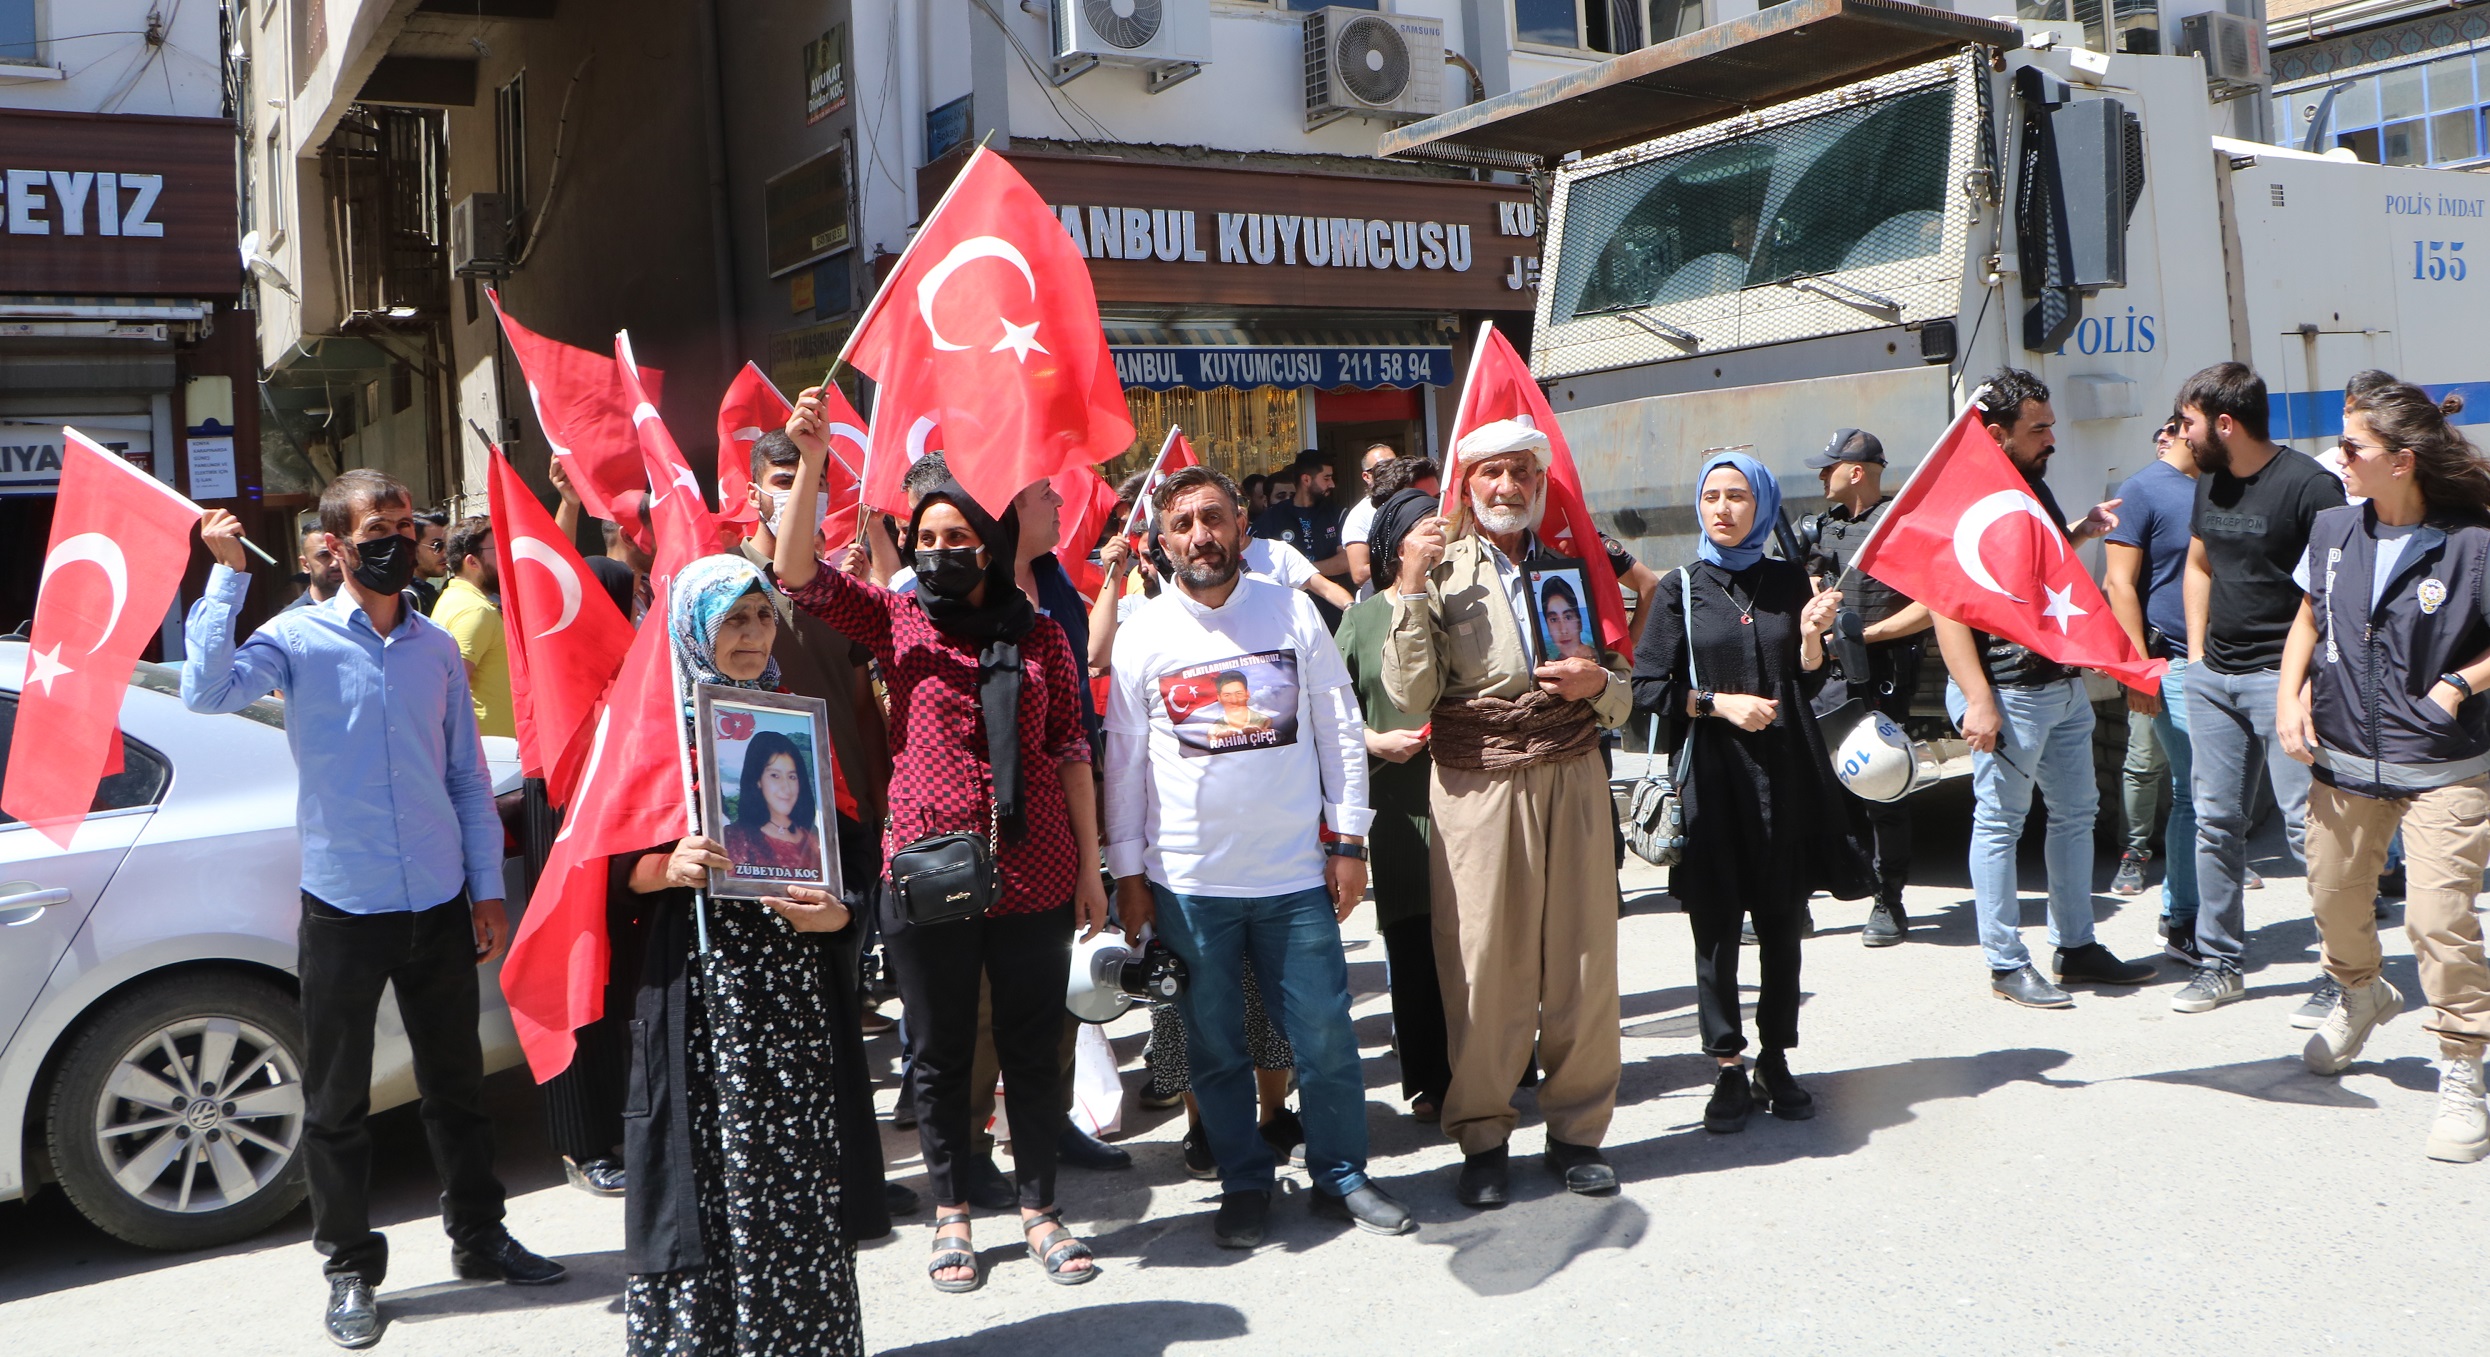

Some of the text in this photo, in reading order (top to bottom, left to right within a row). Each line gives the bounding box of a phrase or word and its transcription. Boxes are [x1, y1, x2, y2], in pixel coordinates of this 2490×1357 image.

[1400, 25, 1440, 36] SAMSUNG
[811, 62, 841, 96] AVUKAT
[0, 169, 164, 237] EYIZ
[2385, 192, 2485, 217] POLİS İMDAT
[1500, 201, 1537, 237] KU
[1047, 205, 1473, 272] ANBUL KUYUMCUSU
[2413, 240, 2466, 281] 155
[1110, 353, 1431, 383] ANBUL KUYUMCUSU 211 58 94
[2206, 515, 2263, 529] PERCEPTION
[1182, 653, 1281, 680] EVLATLARIMIZI İSTİYORUZ
[1209, 728, 1277, 750] RAHİM ÇİFÇİ
[1839, 750, 1871, 786] 104
[735, 862, 819, 881] ZÜBEYDA KOÇ
